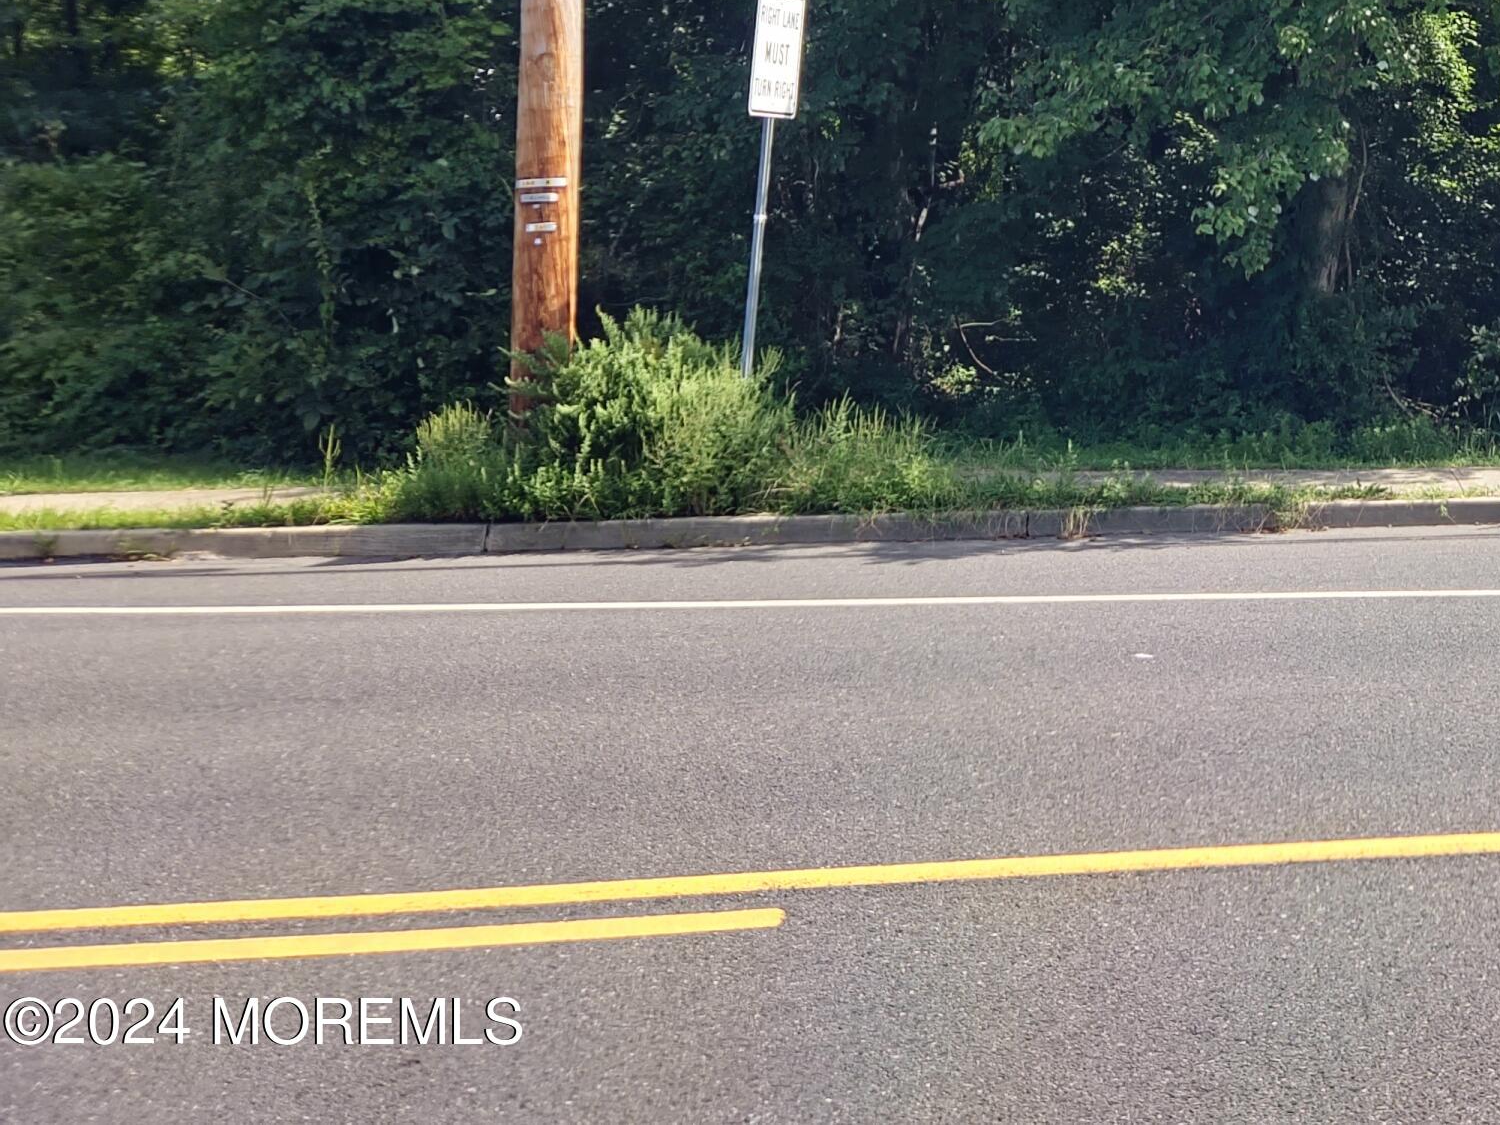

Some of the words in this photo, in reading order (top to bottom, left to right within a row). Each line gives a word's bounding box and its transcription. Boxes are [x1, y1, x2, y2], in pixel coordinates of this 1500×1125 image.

[760, 5, 781, 25] RIGHT
[782, 10, 800, 30] LANE
[764, 41, 790, 65] MUST
[754, 77, 772, 96] TURN
[774, 80, 795, 100] RIGHT
